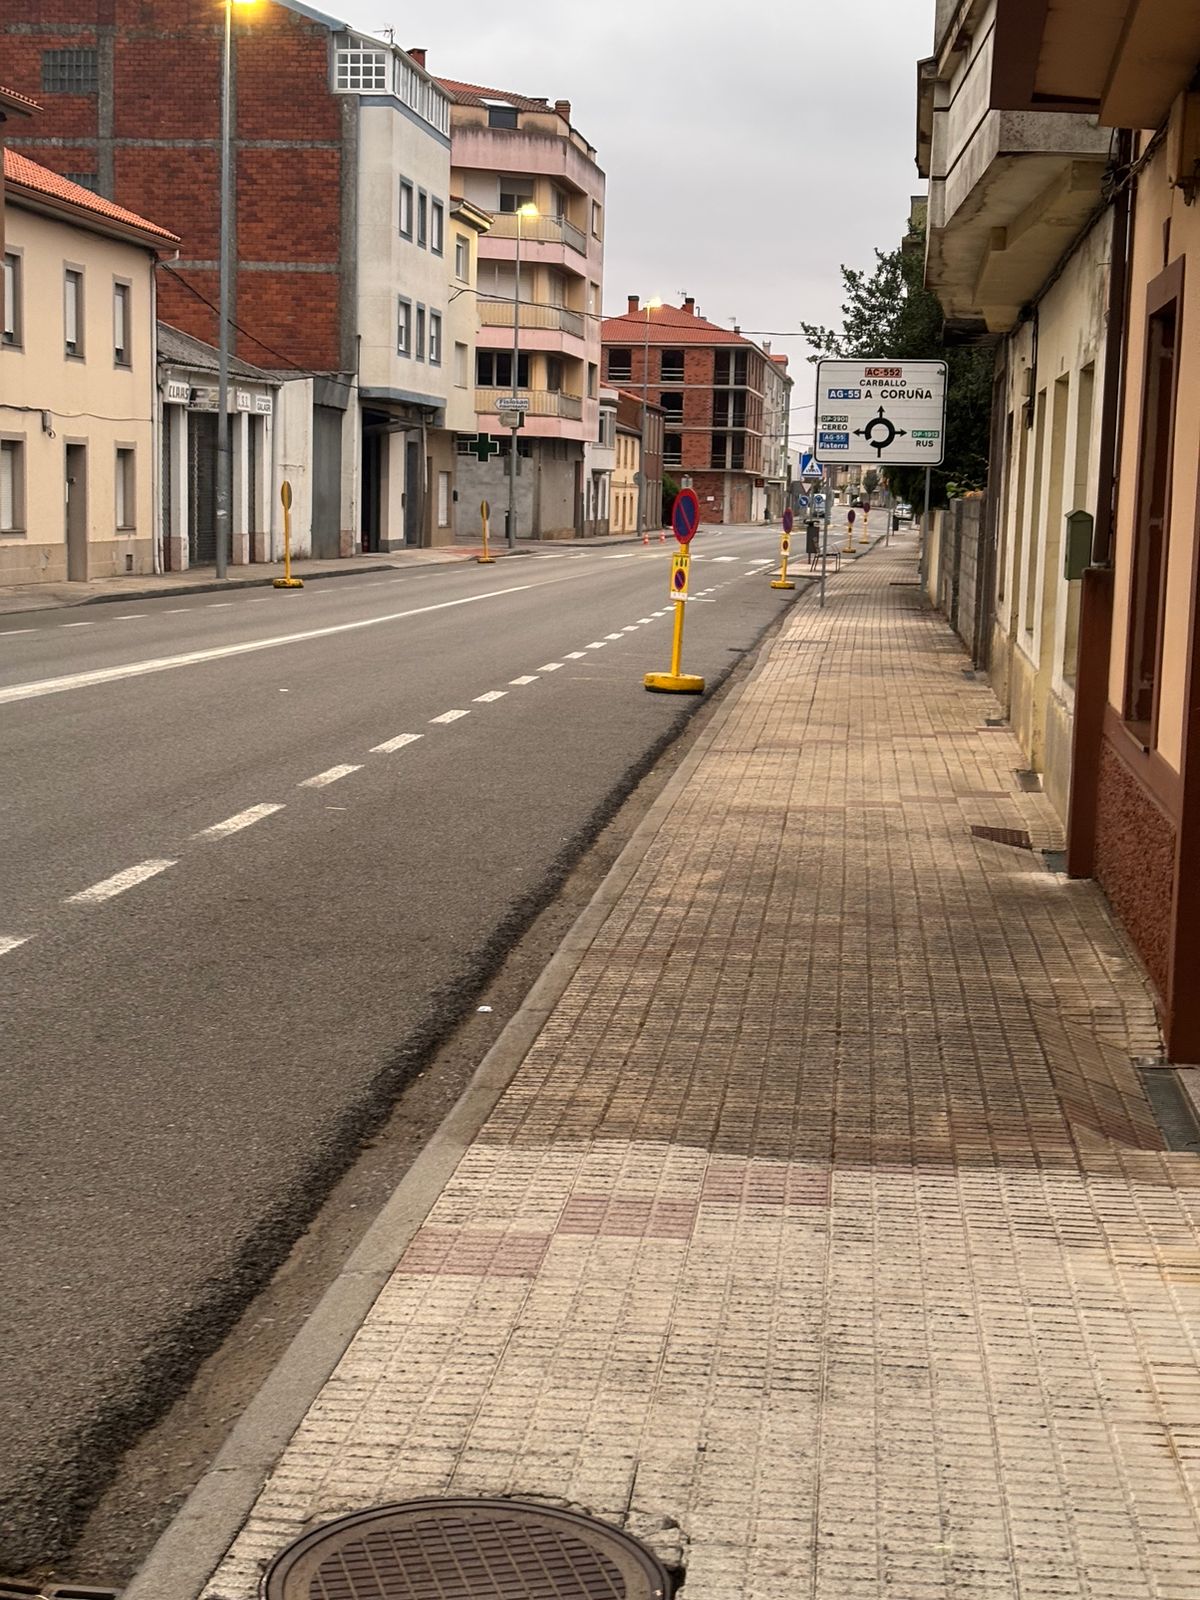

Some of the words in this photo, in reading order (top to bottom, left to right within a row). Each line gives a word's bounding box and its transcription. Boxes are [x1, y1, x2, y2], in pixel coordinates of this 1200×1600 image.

[866, 368, 901, 377] AC-552
[859, 379, 907, 387] CARBALLO
[169, 385, 190, 400] CLAAS
[829, 390, 860, 398] AG-55
[864, 389, 873, 399] A
[880, 387, 932, 399] CORUÑA
[821, 423, 848, 431] CEREO
